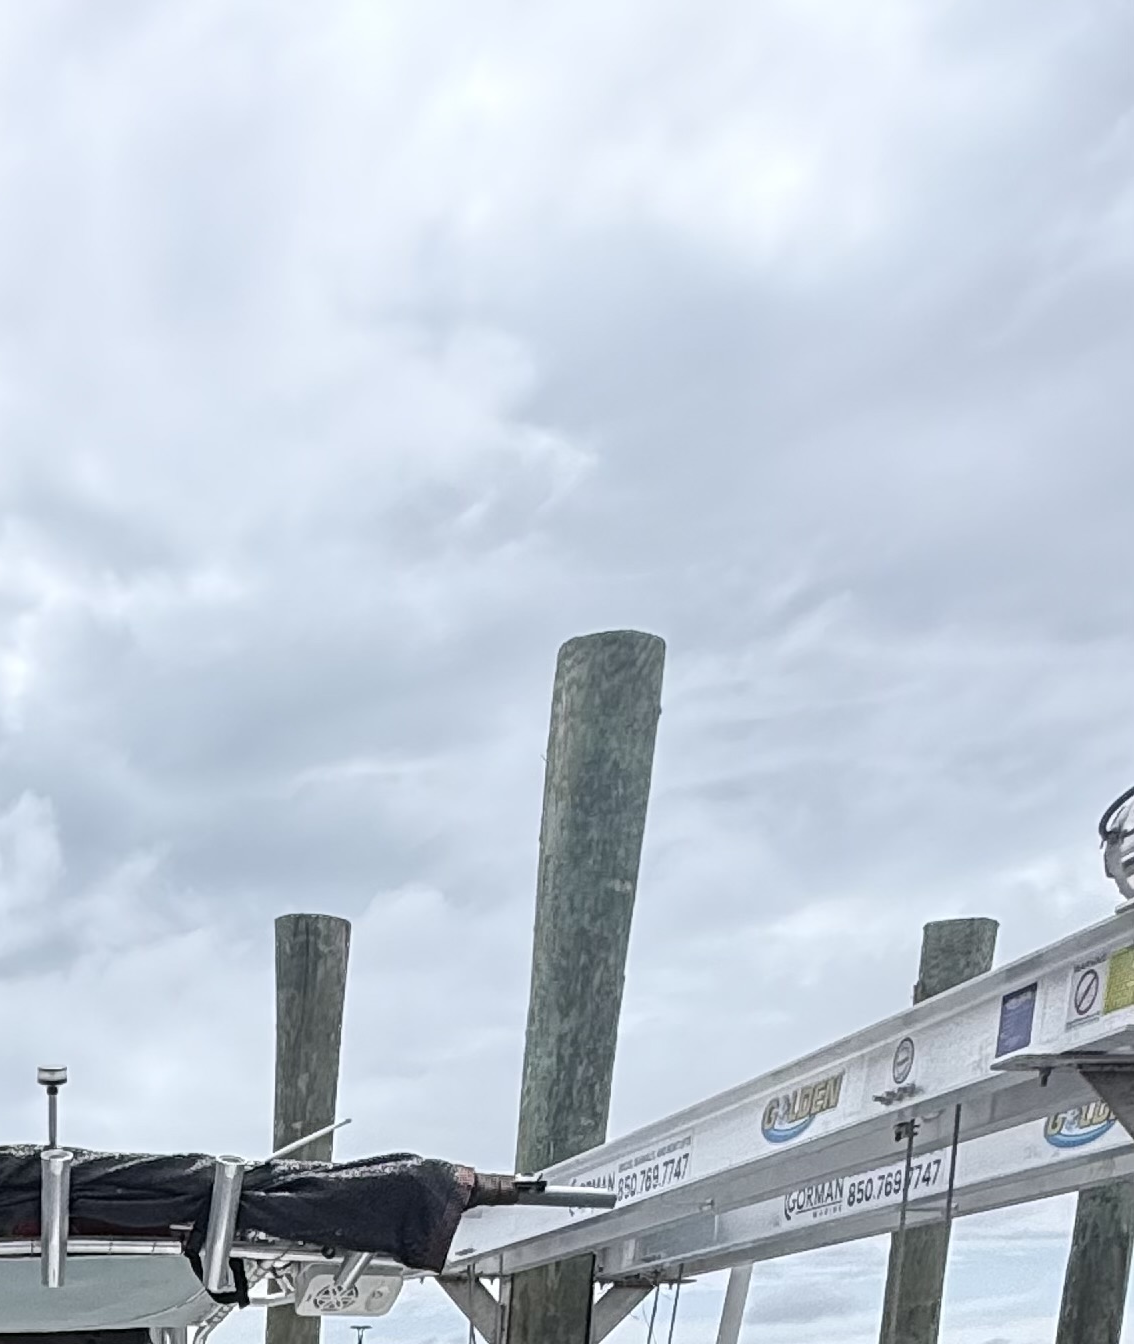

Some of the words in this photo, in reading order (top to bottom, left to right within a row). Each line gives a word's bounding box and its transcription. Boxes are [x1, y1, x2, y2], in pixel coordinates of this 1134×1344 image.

[762, 1069, 846, 1129] GOLDEN
[617, 1152, 690, 1202] 850.769.7747
[785, 1177, 845, 1216] GORMAN
